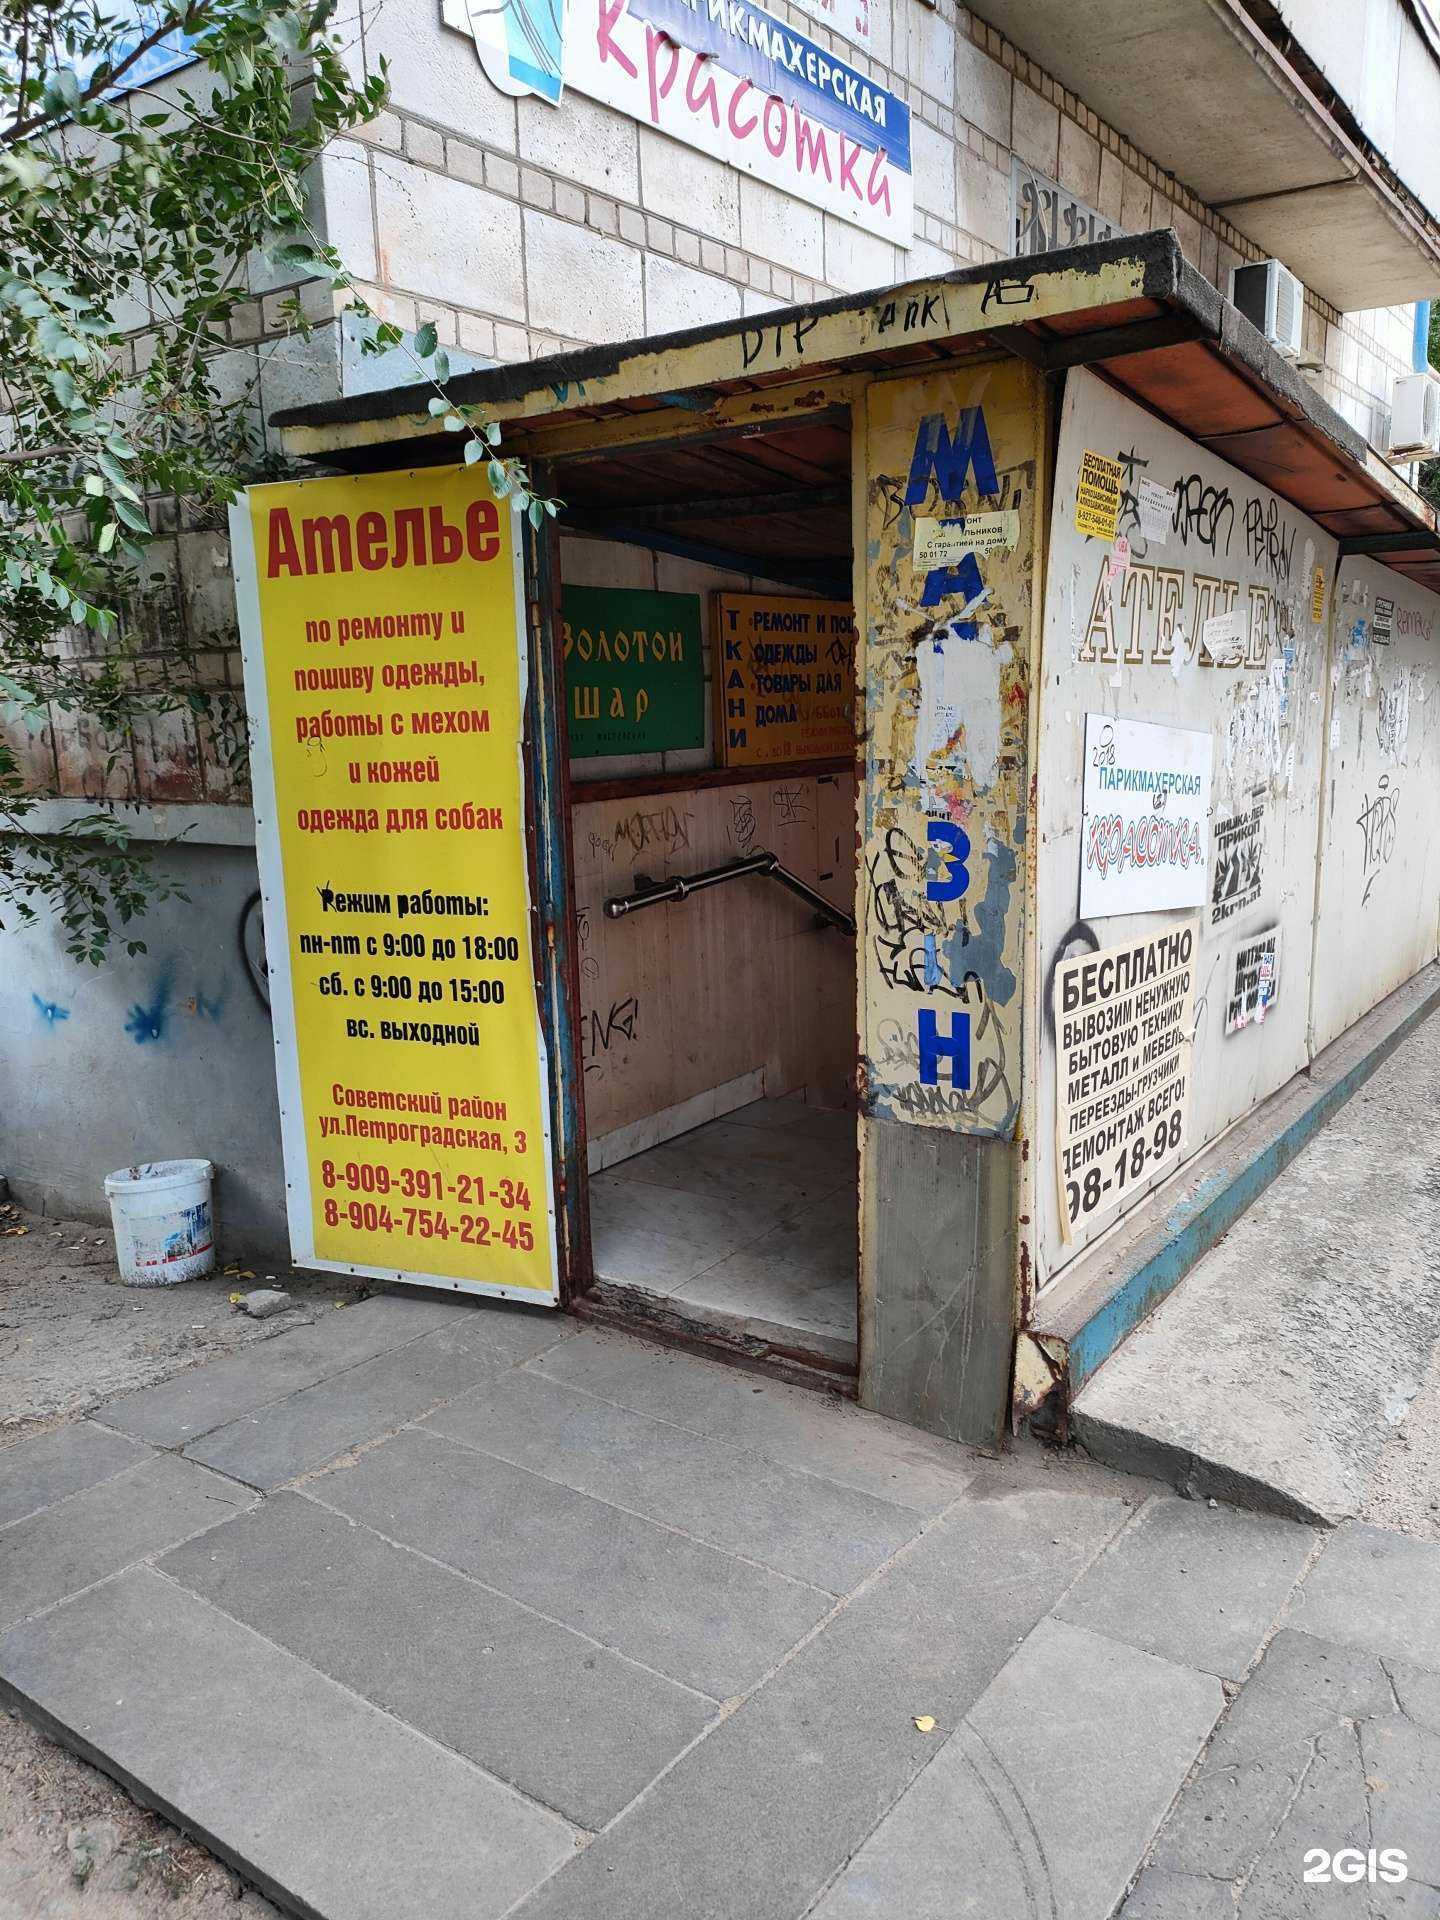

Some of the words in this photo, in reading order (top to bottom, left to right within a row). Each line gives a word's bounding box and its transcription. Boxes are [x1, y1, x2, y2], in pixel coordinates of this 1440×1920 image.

[681, 0, 886, 127] ИКМАХЕРСКАЯ
[1082, 467, 1119, 496] ПОМОЩЬ
[1084, 452, 1121, 480] БЕСПЛАТНАЯ
[267, 500, 501, 579] Ателье
[987, 536, 1008, 546] дому
[305, 618, 331, 643] по
[337, 611, 444, 646] ремонту
[451, 611, 465, 634] и
[753, 611, 811, 633] РЕМОНТ
[816, 612, 826, 633] И
[754, 642, 817, 667] ОДЕЖДЫ
[294, 663, 374, 693] пошиву
[382, 659, 485, 690] одежды,
[726, 610, 747, 748] ТКАНИ
[755, 672, 811, 695] ТОВАРЫ
[815, 673, 842, 695] ДЛЯ
[296, 709, 383, 743] работы
[391, 712, 404, 735] с
[411, 710, 490, 735] мехом
[755, 703, 798, 728] ДОМА
[348, 759, 361, 784] и
[367, 755, 440, 784] кожей
[1099, 766, 1201, 796] ПАРИКМАХЕРСКАЯ
[297, 808, 379, 834] одежда
[386, 807, 428, 833] для
[435, 802, 504, 831] собак
[321, 889, 391, 916] Режим
[397, 890, 489, 918] работы:
[300, 934, 361, 957] пн-пт
[366, 936, 377, 957] с
[384, 933, 425, 957] 9:00
[432, 938, 456, 961] до
[464, 936, 519, 961] 18:00
[1062, 928, 1192, 1013] БЕСПЛАТНО
[318, 972, 348, 996] сб.
[354, 977, 365, 997] с
[370, 975, 412, 999] 9:00
[418, 980, 443, 1002] до
[449, 978, 505, 1004] 15:00
[1063, 1002, 1132, 1050] ВЫВОЗИМ
[1135, 970, 1190, 1018] НЕНУЖНУЮ
[346, 1018, 375, 1039] вс.
[381, 1020, 480, 1046] выходной
[1068, 1028, 1138, 1076] БЫТОВУЮ
[1141, 1000, 1184, 1041] ТЕХНИКУ
[1068, 1056, 1129, 1104] МЕТАЛЛ
[1142, 1026, 1185, 1066] МЕБЕЛЬ
[332, 1083, 443, 1115] Советский
[448, 1095, 507, 1121] район
[1069, 1052, 1180, 1134] ПЕРЕЕЗДЫ-ГРУЗЧИКИ
[1148, 1075, 1185, 1122] ВСЕГО!
[319, 1114, 508, 1154] ул.Петроградская,
[514, 1130, 527, 1154] 3
[321, 1160, 531, 1211] 8-909-391-21-34
[324, 1199, 534, 1252] 8-904-754-22-45
